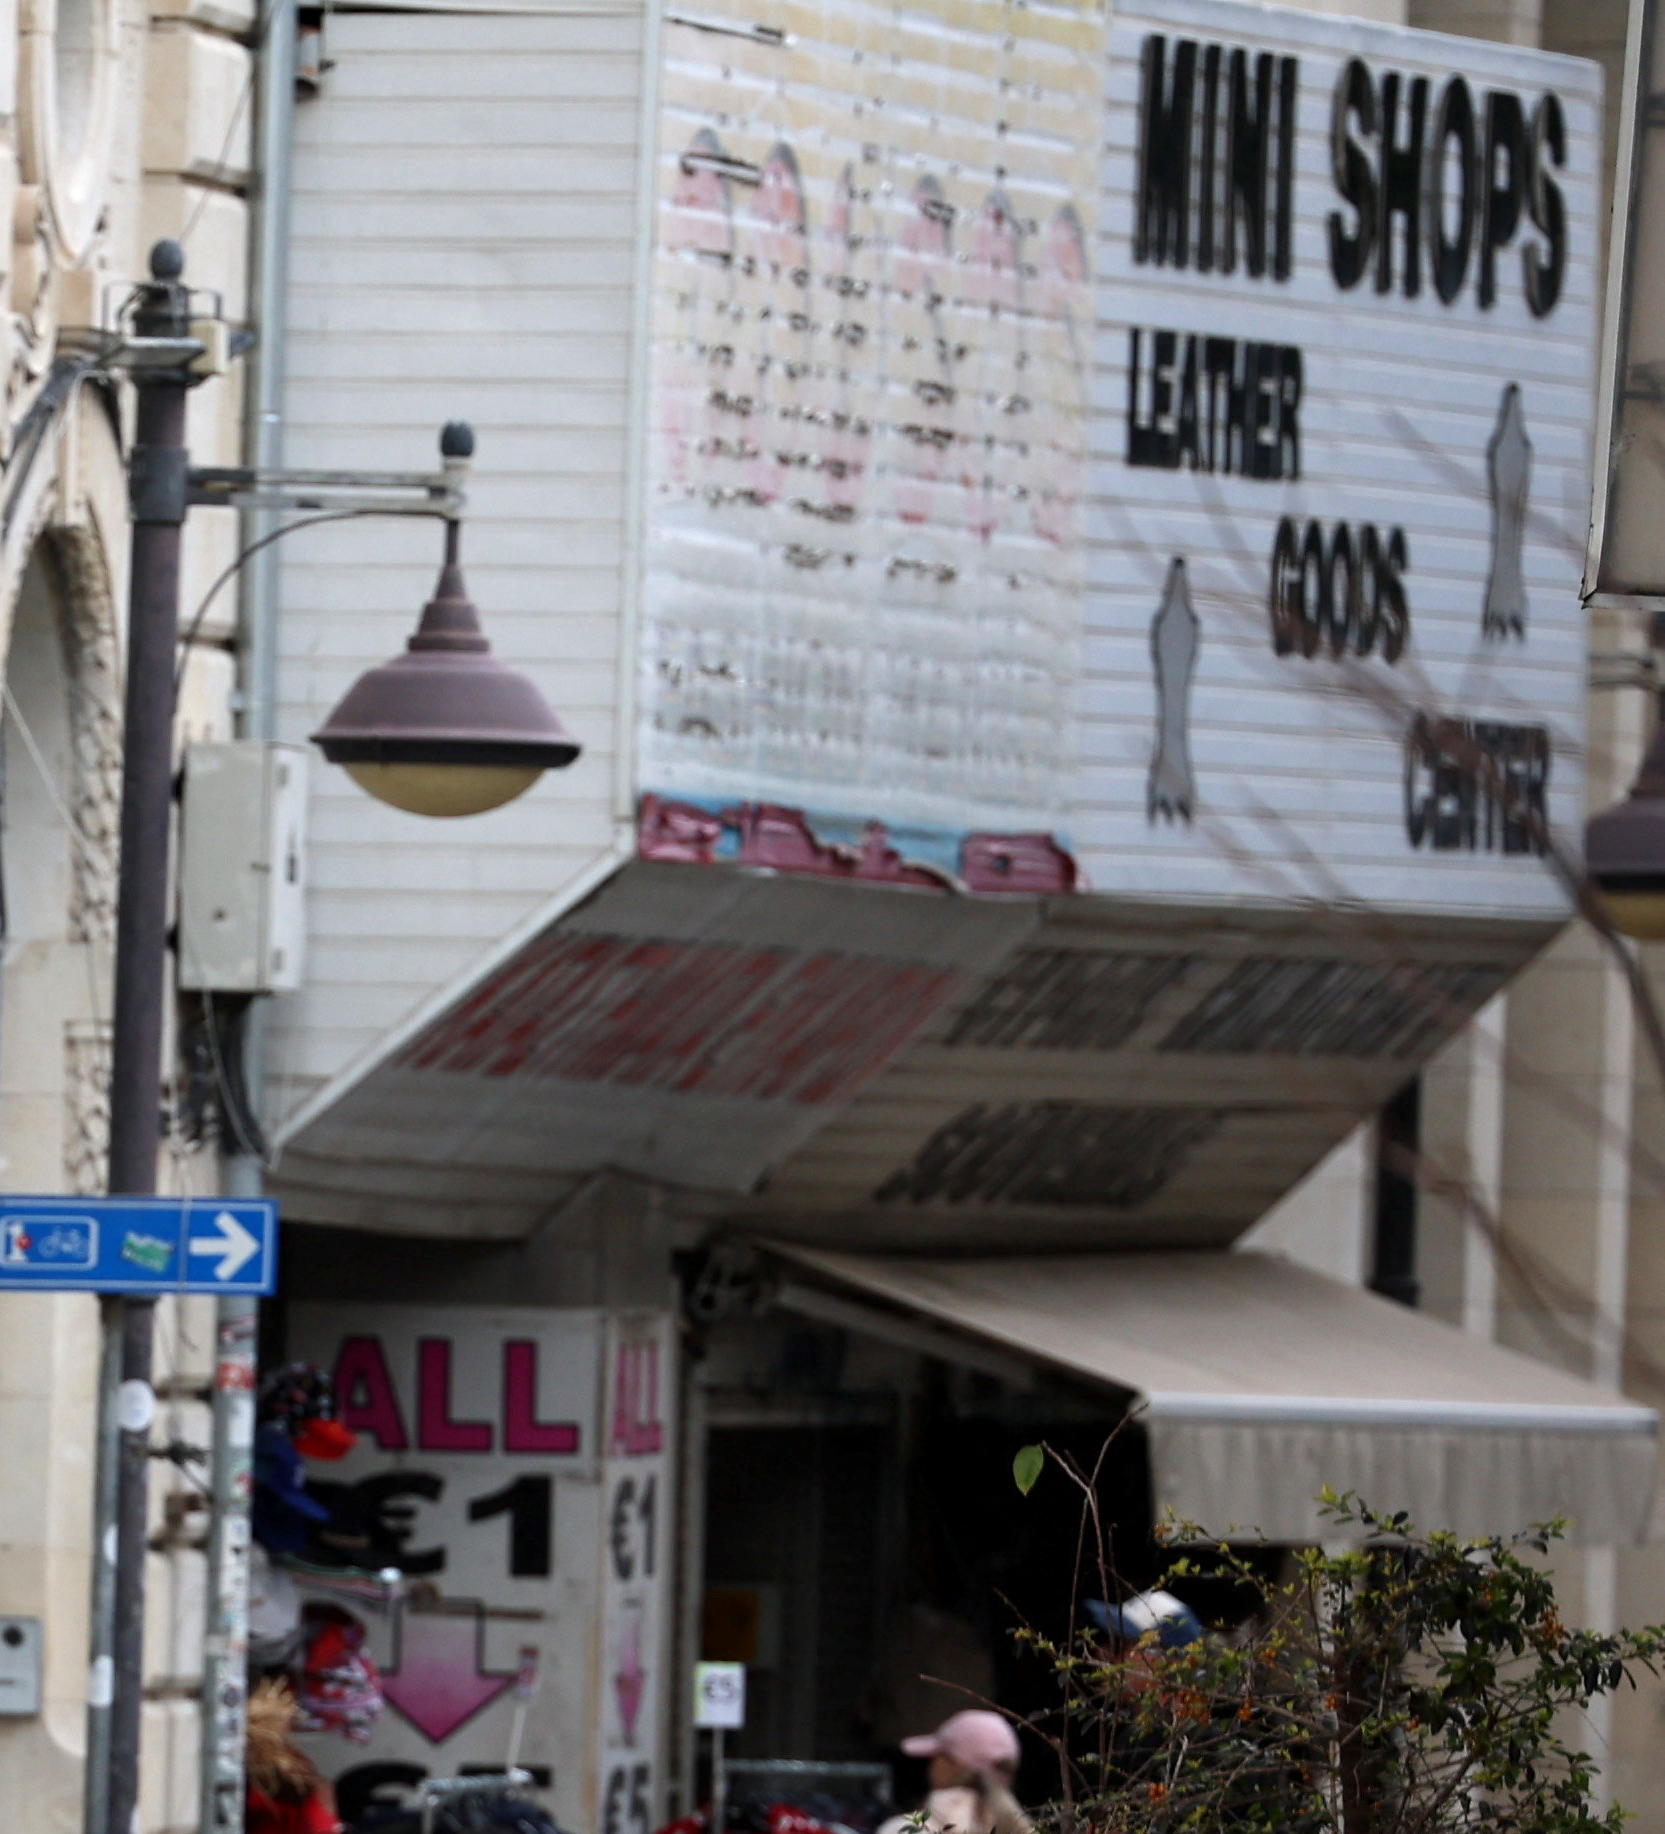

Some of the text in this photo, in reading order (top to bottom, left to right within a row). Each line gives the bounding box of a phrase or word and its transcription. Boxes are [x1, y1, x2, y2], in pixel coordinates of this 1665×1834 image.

[1133, 34, 1298, 282] MINI
[1325, 56, 1567, 320] SHOPS
[1126, 327, 1303, 482] LEATHER
[1270, 515, 1409, 665] GOODS
[333, 1336, 579, 1454] ALL
[610, 1340, 662, 1455] ALL
[357, 1470, 552, 1577] €1
[611, 1472, 657, 1580] €1
